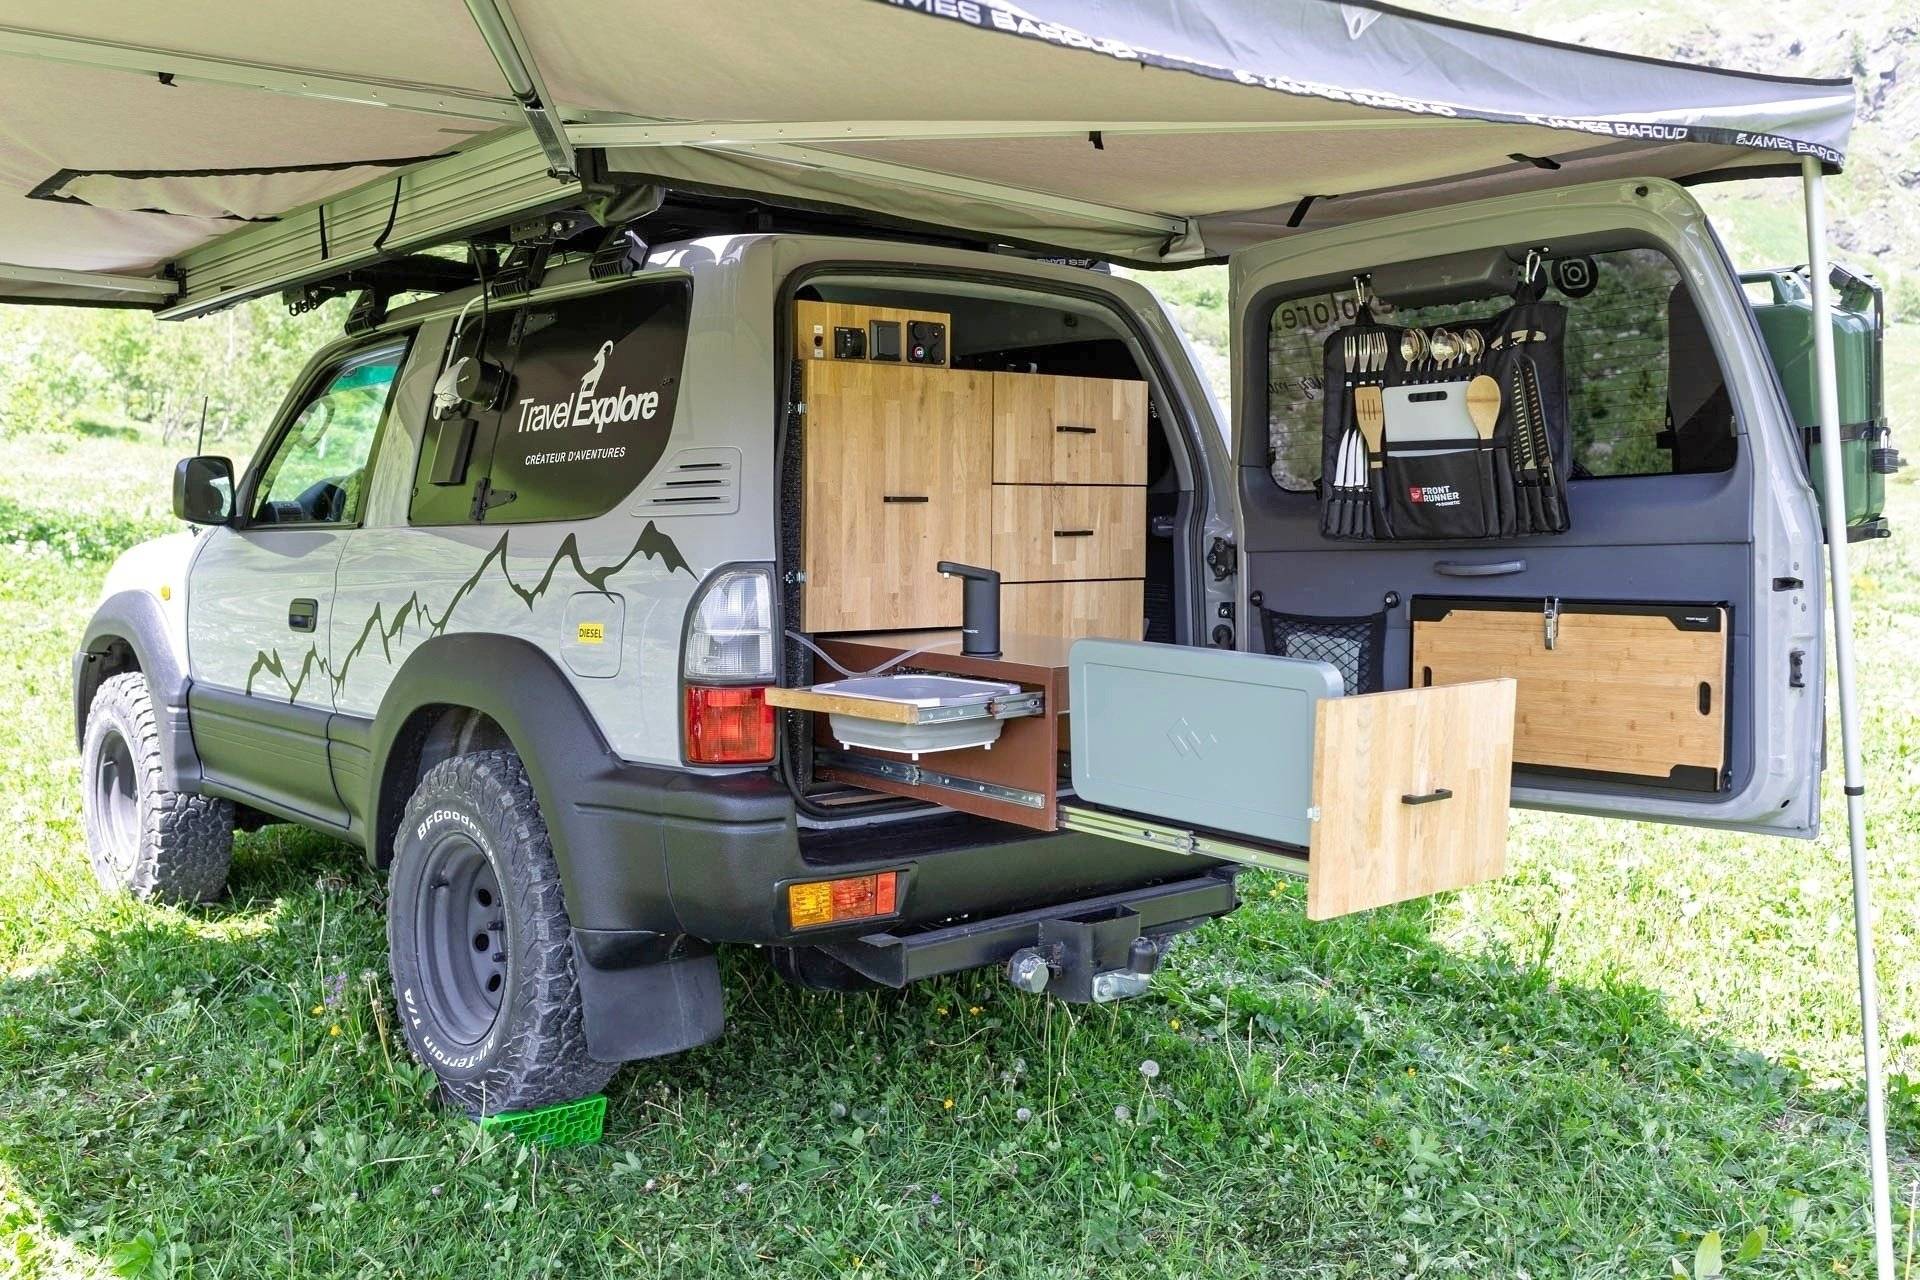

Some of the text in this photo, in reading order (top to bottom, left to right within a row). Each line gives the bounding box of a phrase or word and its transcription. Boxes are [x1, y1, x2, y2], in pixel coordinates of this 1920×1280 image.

[887, 0, 981, 24] MES
[1615, 123, 1689, 140] BAROUD
[1797, 142, 1845, 165] BAROU
[525, 446, 626, 466] CRÉATEUR D'AVENTURES
[1421, 485, 1450, 495] FRONT
[1423, 491, 1460, 503] RUNNER
[579, 628, 602, 639] DIESEL
[417, 810, 495, 865] BFGoodrich
[404, 988, 421, 1030] T/A
